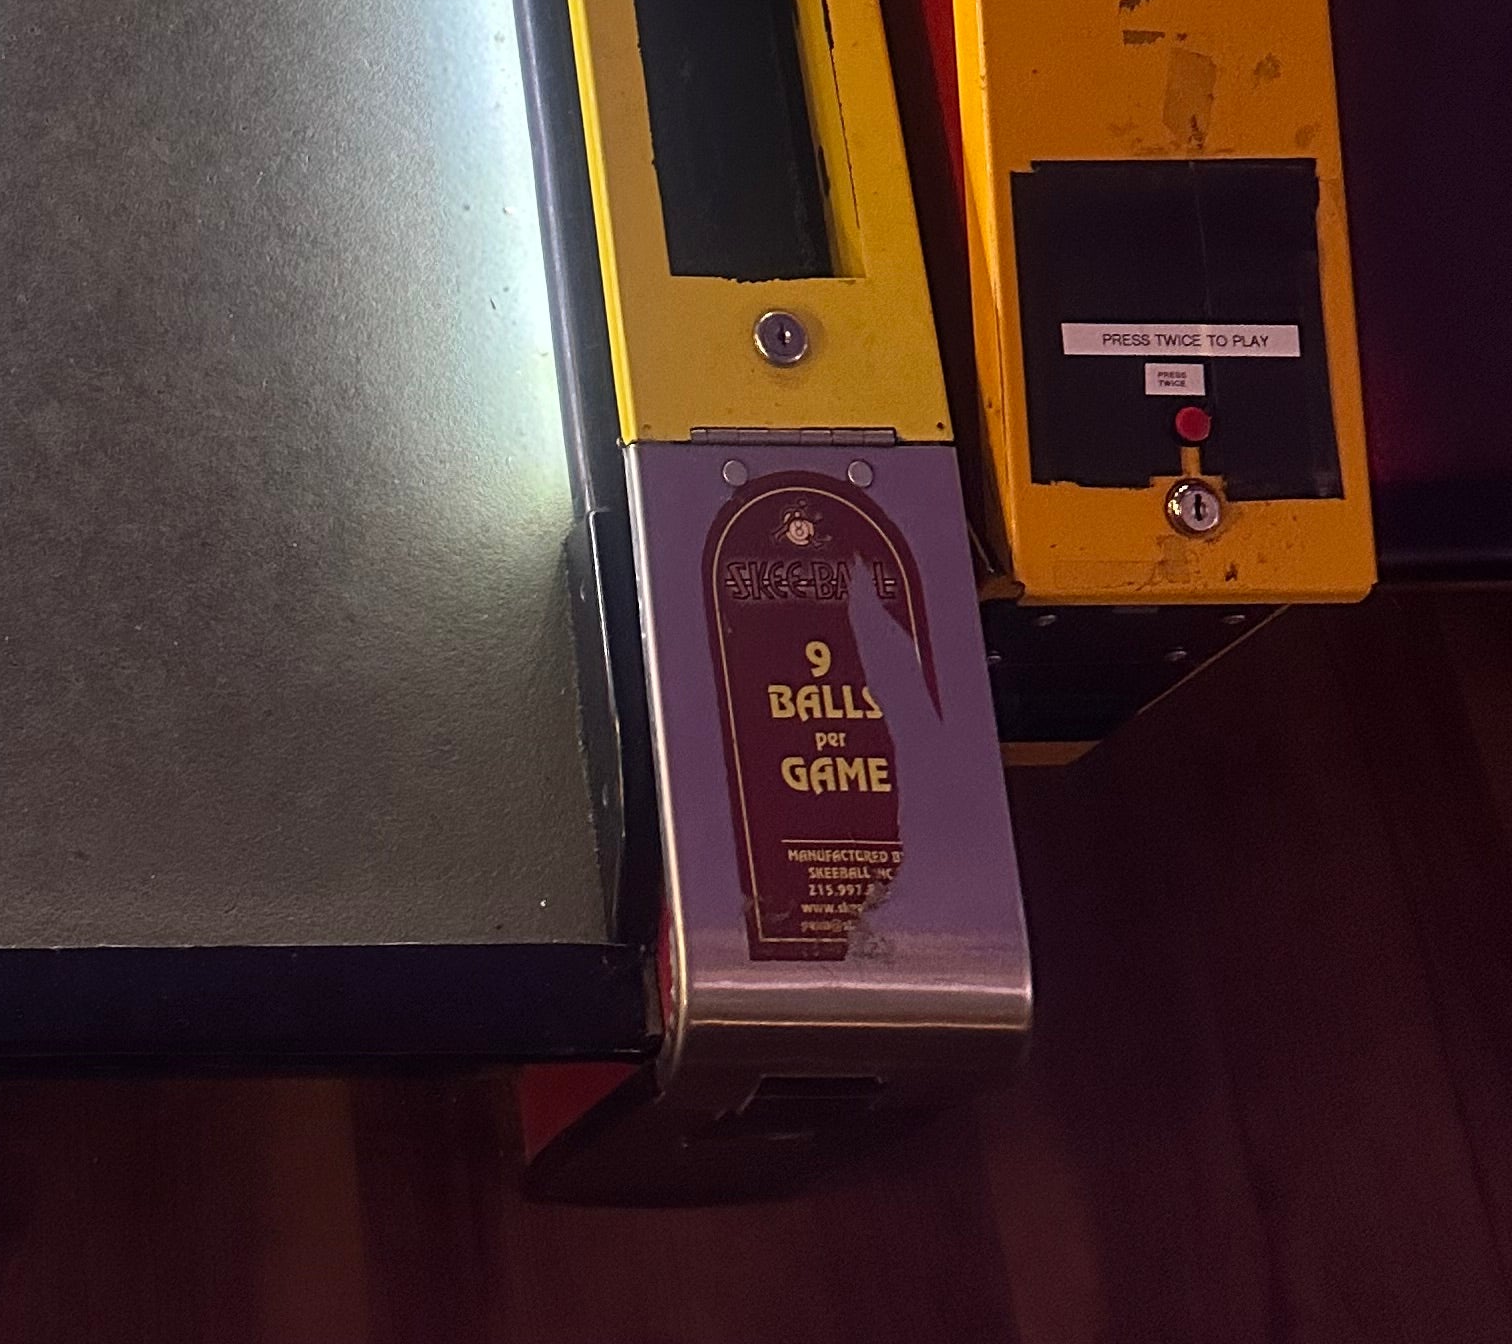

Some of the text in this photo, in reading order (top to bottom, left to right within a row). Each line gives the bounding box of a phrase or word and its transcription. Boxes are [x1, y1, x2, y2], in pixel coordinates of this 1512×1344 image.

[1102, 332, 1269, 348] PRESS TWICE TO PLAY
[1157, 371, 1187, 379] PRESS
[1159, 379, 1187, 387] TWICE
[804, 640, 832, 678] 9
[767, 684, 884, 722] BALLS
[815, 731, 846, 751] per
[780, 756, 892, 795] GAME
[788, 848, 888, 863] MANUFACTURED
[808, 866, 871, 880] SKEEBALL
